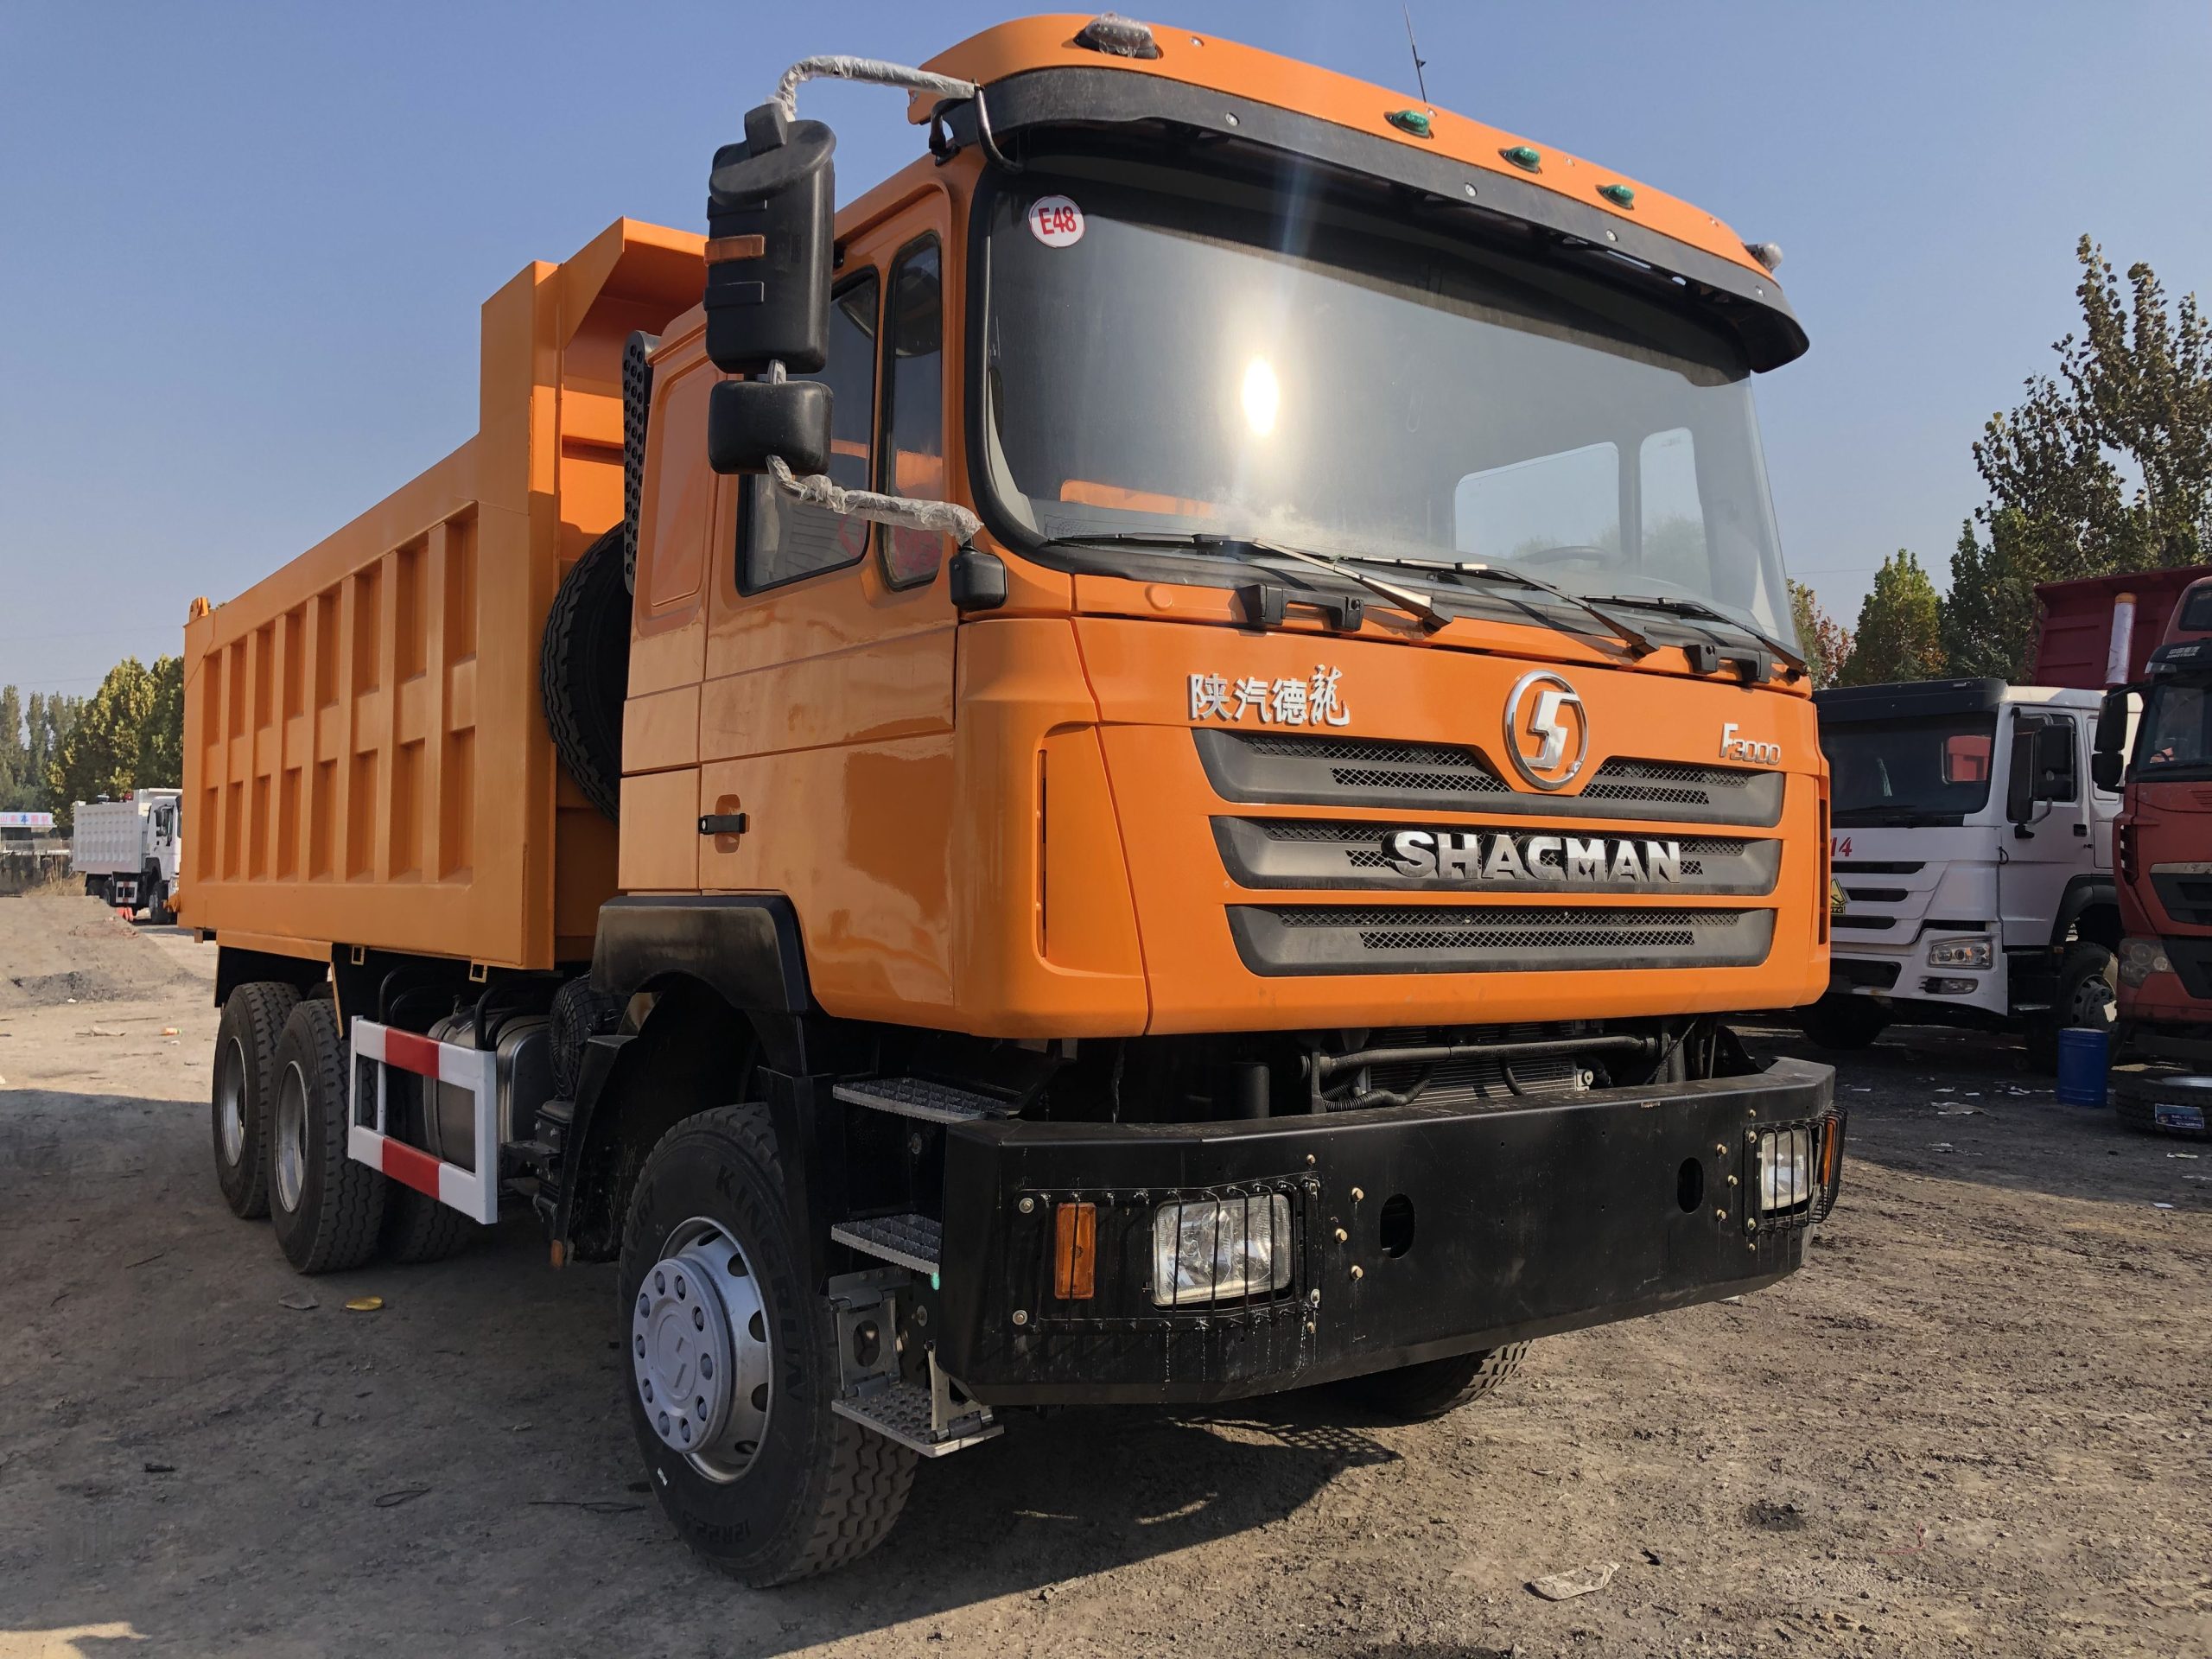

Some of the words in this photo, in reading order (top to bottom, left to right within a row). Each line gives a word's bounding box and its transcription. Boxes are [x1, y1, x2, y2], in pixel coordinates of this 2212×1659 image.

[1038, 206, 1077, 235] E48
[1719, 722, 1781, 765] F3000
[1383, 830, 1681, 883] SHACMAN
[715, 1164, 804, 1402] KINGRUN
